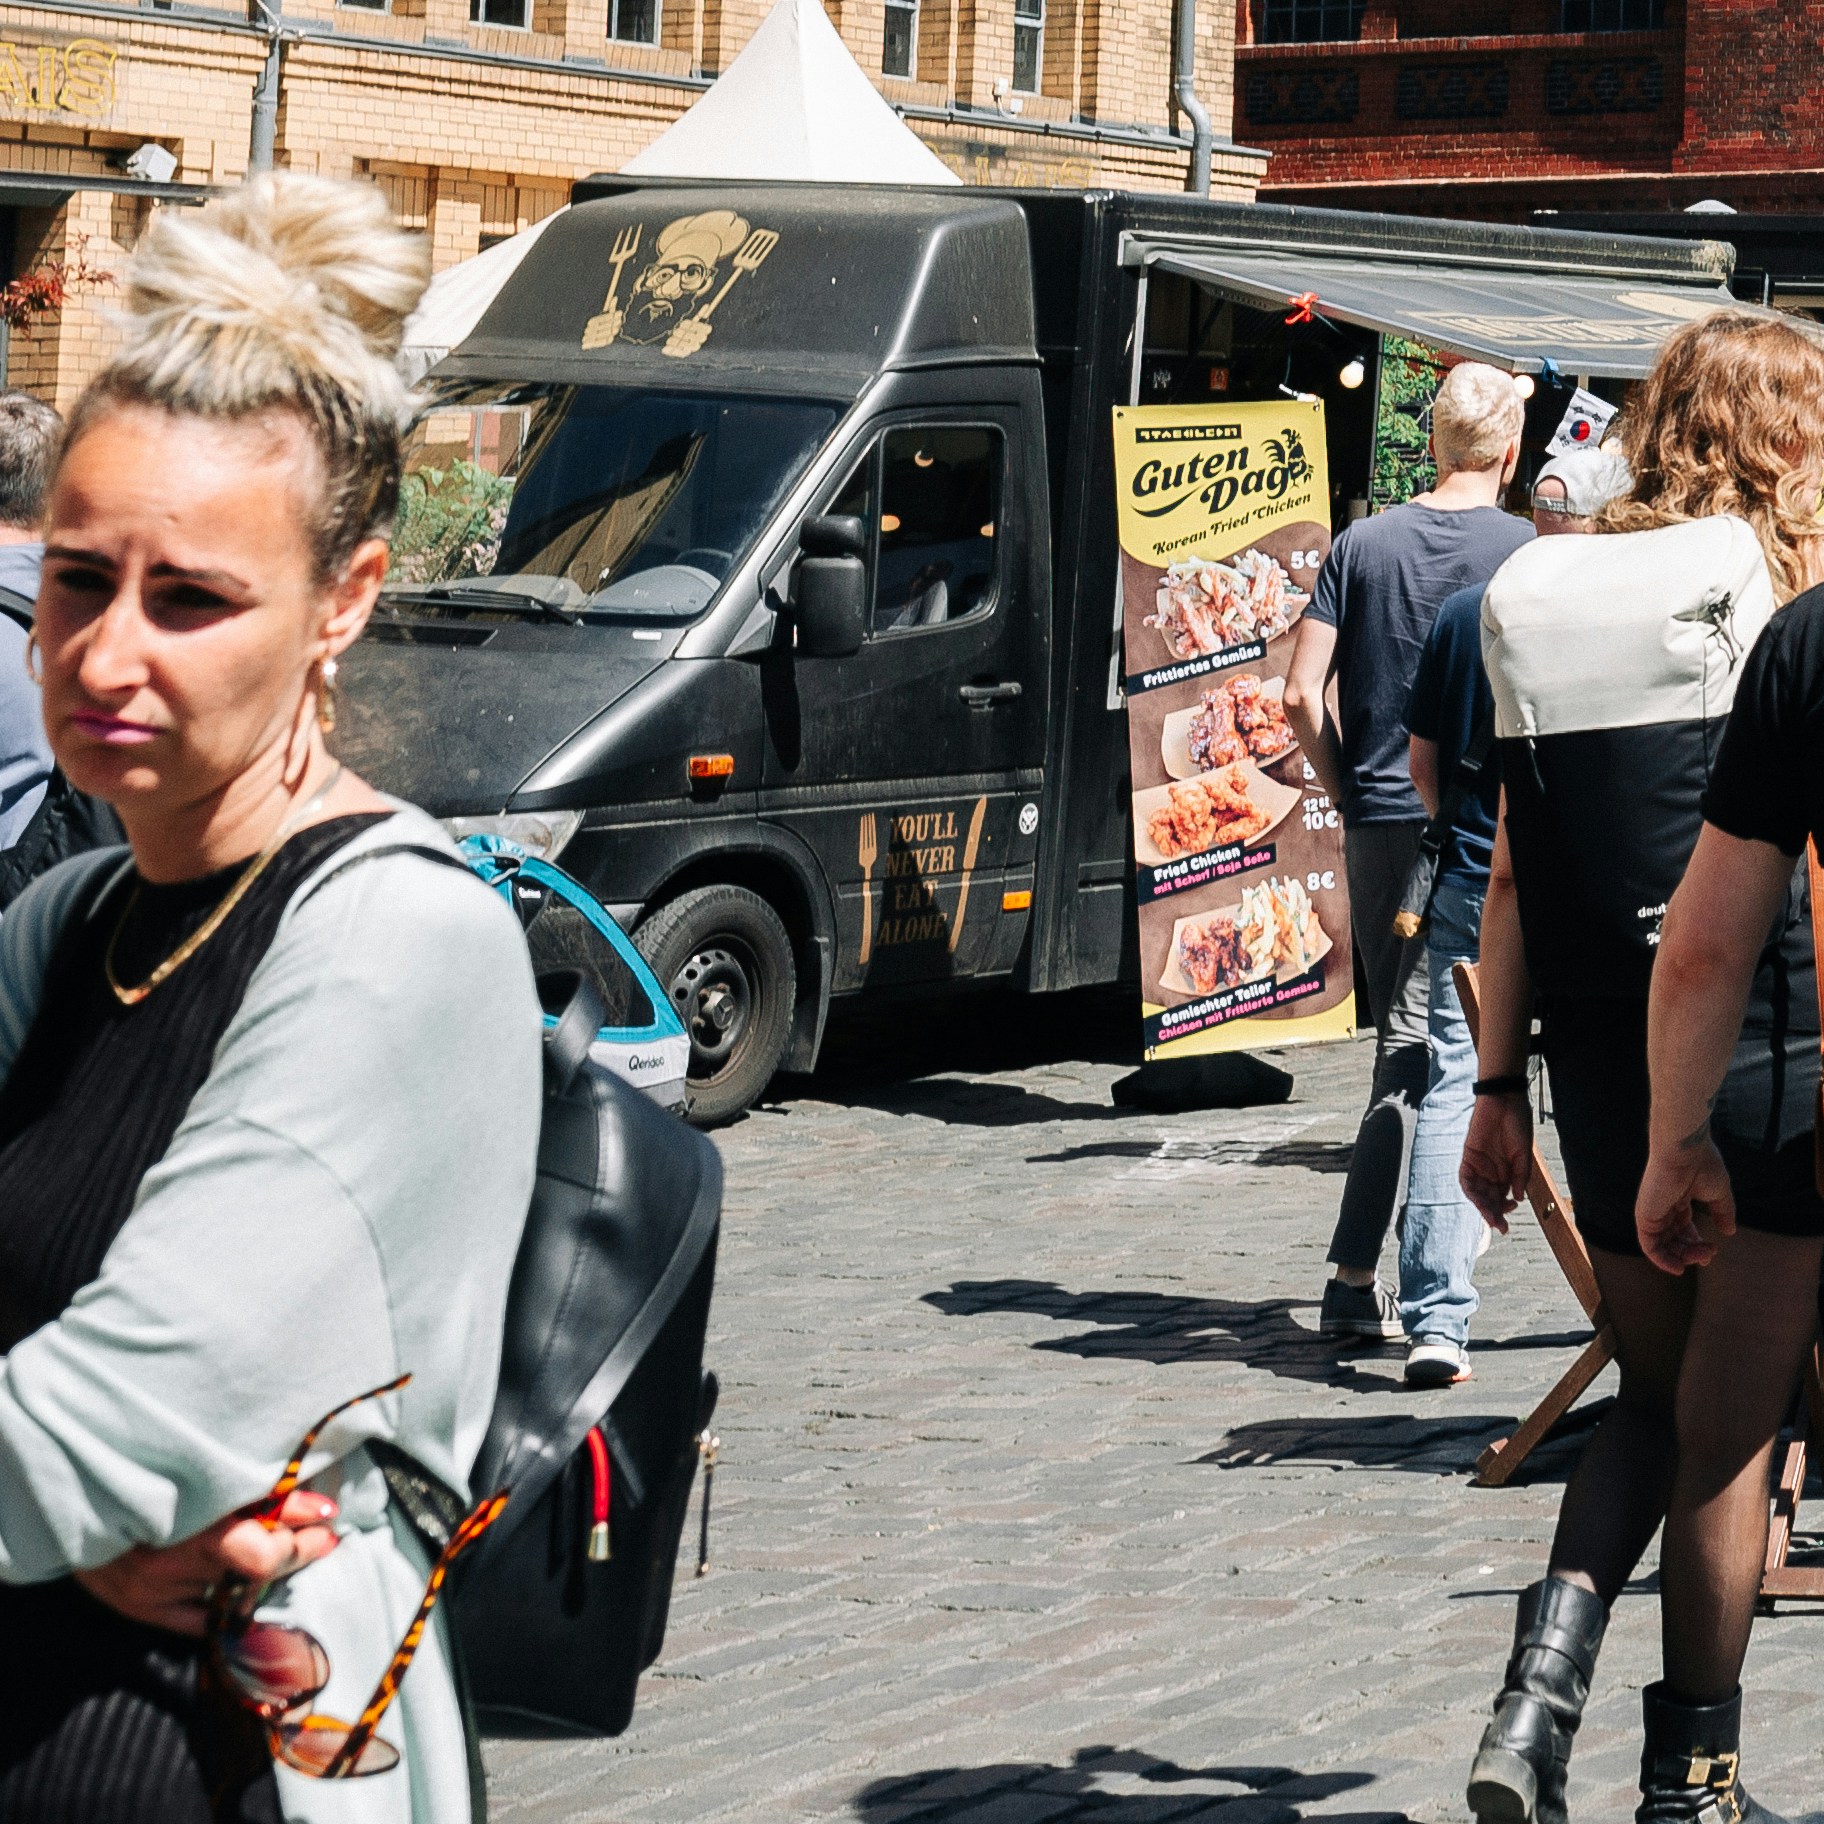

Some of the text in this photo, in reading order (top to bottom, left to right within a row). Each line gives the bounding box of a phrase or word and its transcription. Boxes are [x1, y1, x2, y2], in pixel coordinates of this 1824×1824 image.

[1132, 446, 1250, 498] Guten
[1200, 464, 1290, 515] Dag
[1153, 492, 1312, 556] Korean Fried Chicken
[1290, 550, 1321, 570] 5€
[1143, 644, 1262, 689] Frittiertes Gemüse
[889, 811, 958, 844] YOU'LL
[1302, 809, 1339, 832] 10€
[885, 845, 955, 878] NEVER
[1153, 846, 1241, 883] Fried Chicken
[894, 879, 939, 911] EAT
[1153, 880, 1173, 895] mit
[1306, 870, 1336, 892] 8€
[876, 912, 948, 946] ALONE
[1158, 1018, 1203, 1041] Chicken
[1205, 1012, 1224, 1027] mit
[1275, 979, 1321, 1002] Gemüse
[1161, 981, 1272, 1028] Gemischter Teller
